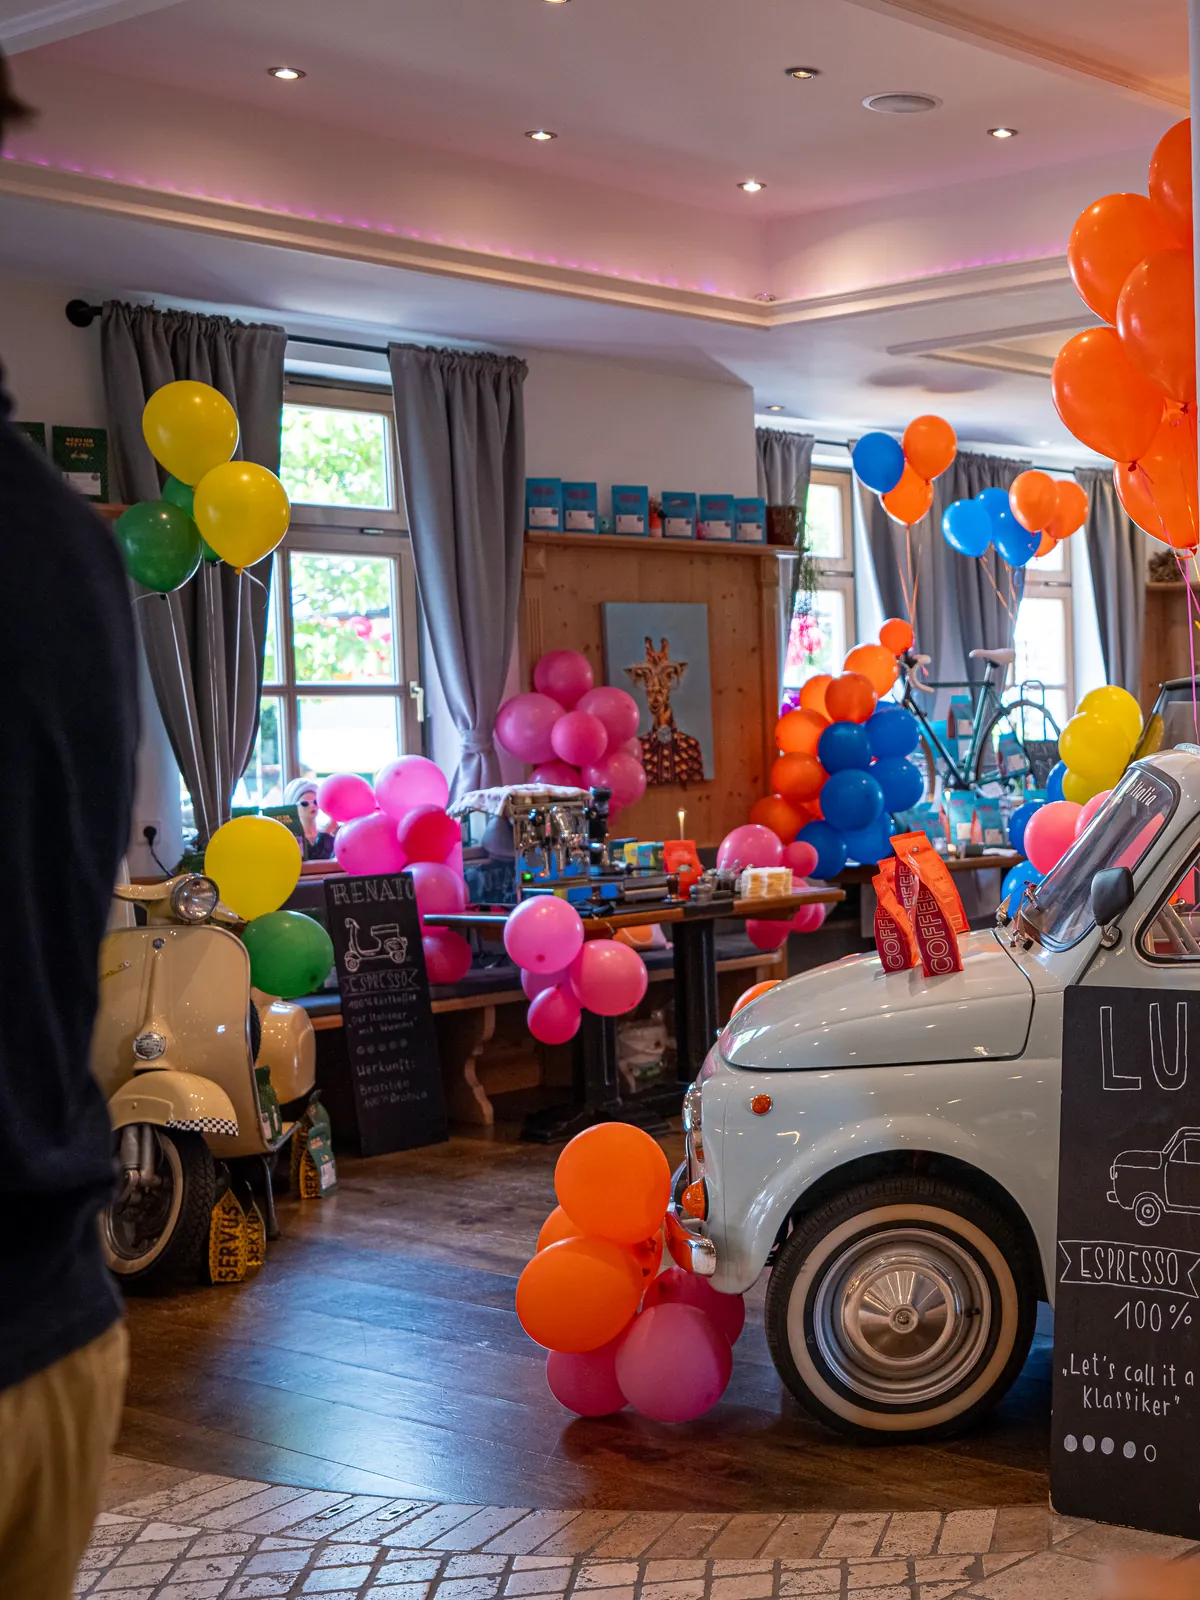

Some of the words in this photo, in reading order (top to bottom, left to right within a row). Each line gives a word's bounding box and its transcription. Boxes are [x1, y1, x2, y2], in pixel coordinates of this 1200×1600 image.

[330, 878, 415, 905] RENATO
[916, 890, 954, 974] COFFEE
[349, 970, 407, 992] ESPRESSO
[218, 1207, 240, 1280] SERVUS
[1080, 1246, 1178, 1285] ESPRESSO
[1114, 1301, 1192, 1332] 100%
[1124, 1364, 1156, 1386] call
[1163, 1364, 1176, 1386] it
[1184, 1371, 1194, 1386] a
